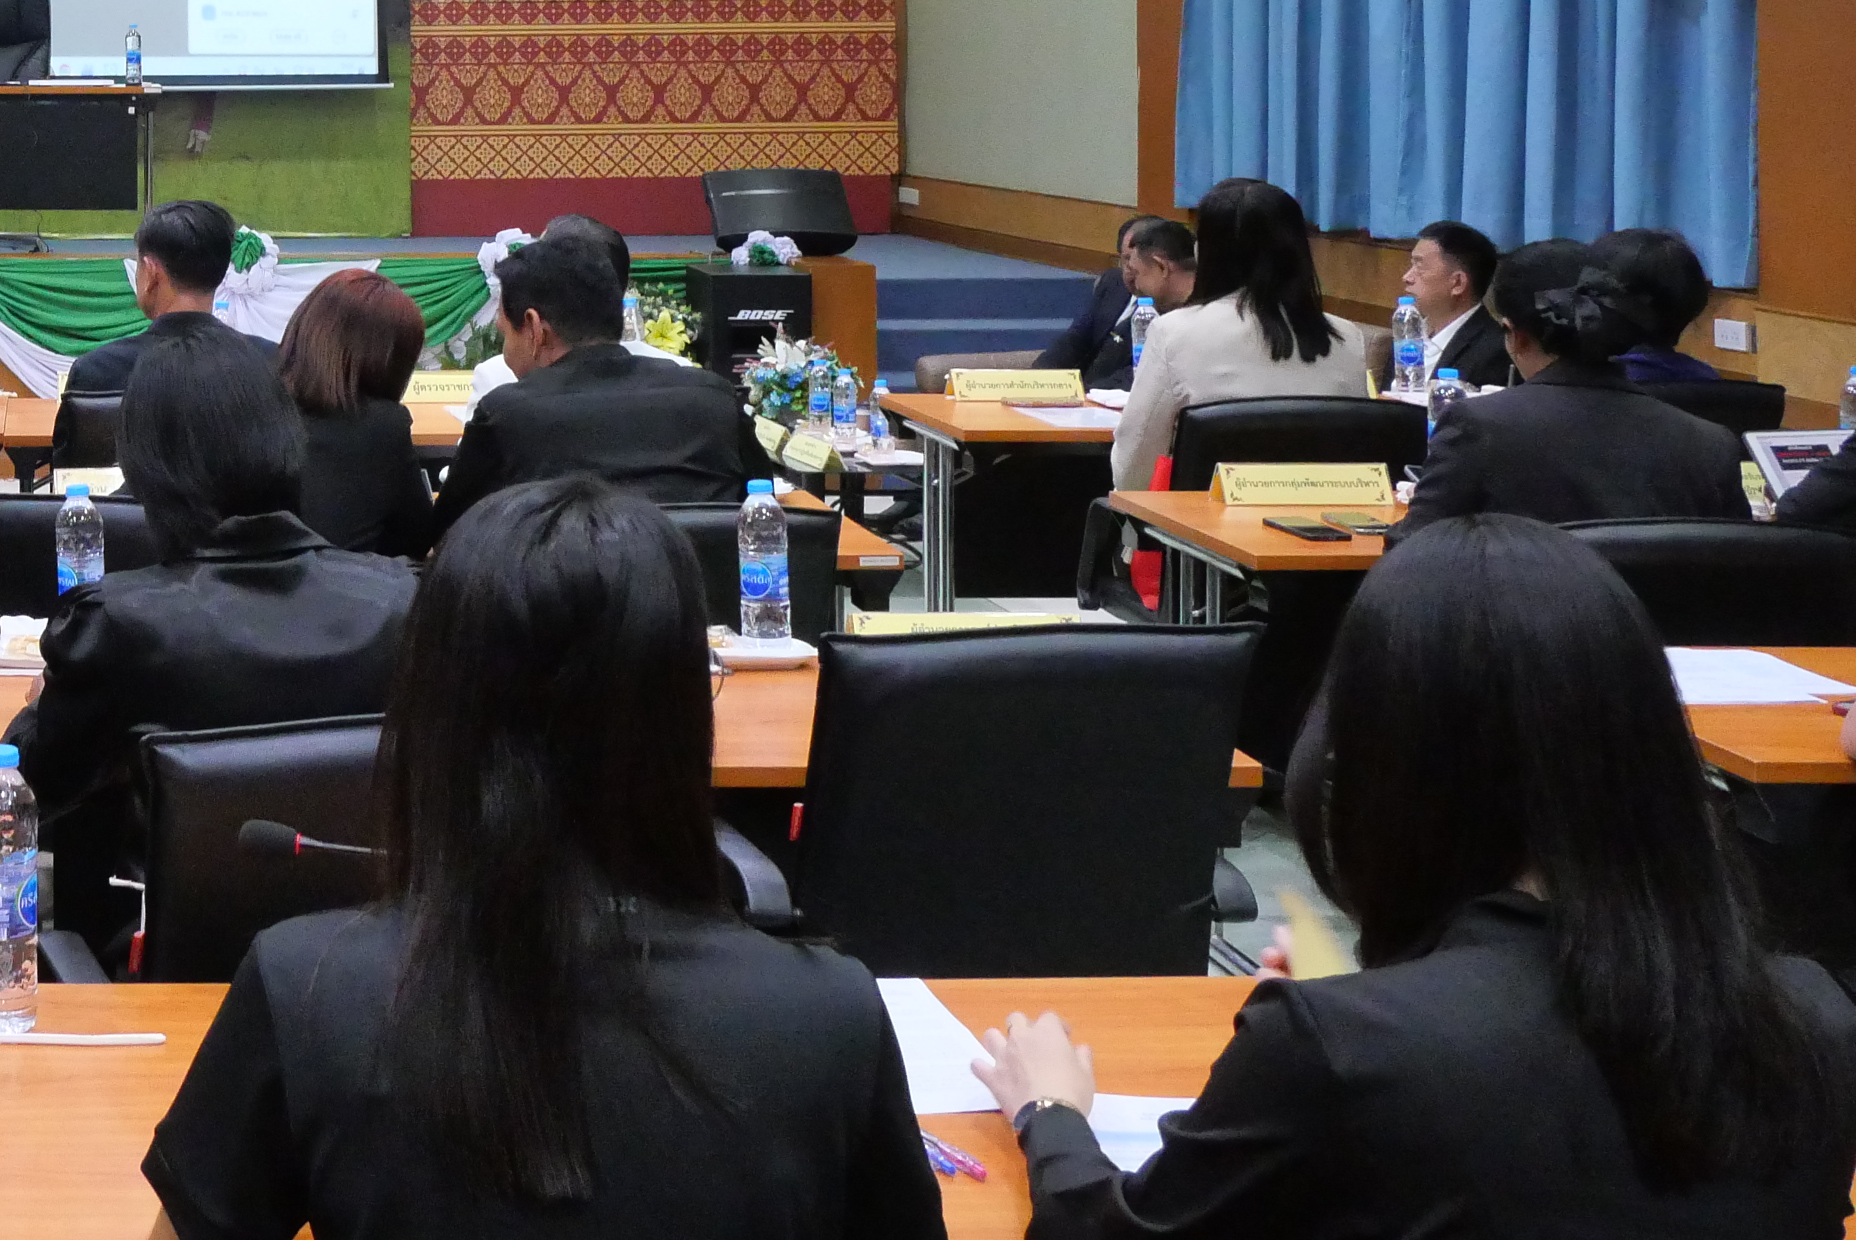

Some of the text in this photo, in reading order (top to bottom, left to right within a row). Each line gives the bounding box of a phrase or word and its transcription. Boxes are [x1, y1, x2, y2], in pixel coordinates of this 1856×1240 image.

[727, 309, 795, 321] BOSE
[412, 380, 476, 396] ผู้ตรวจราชกา
